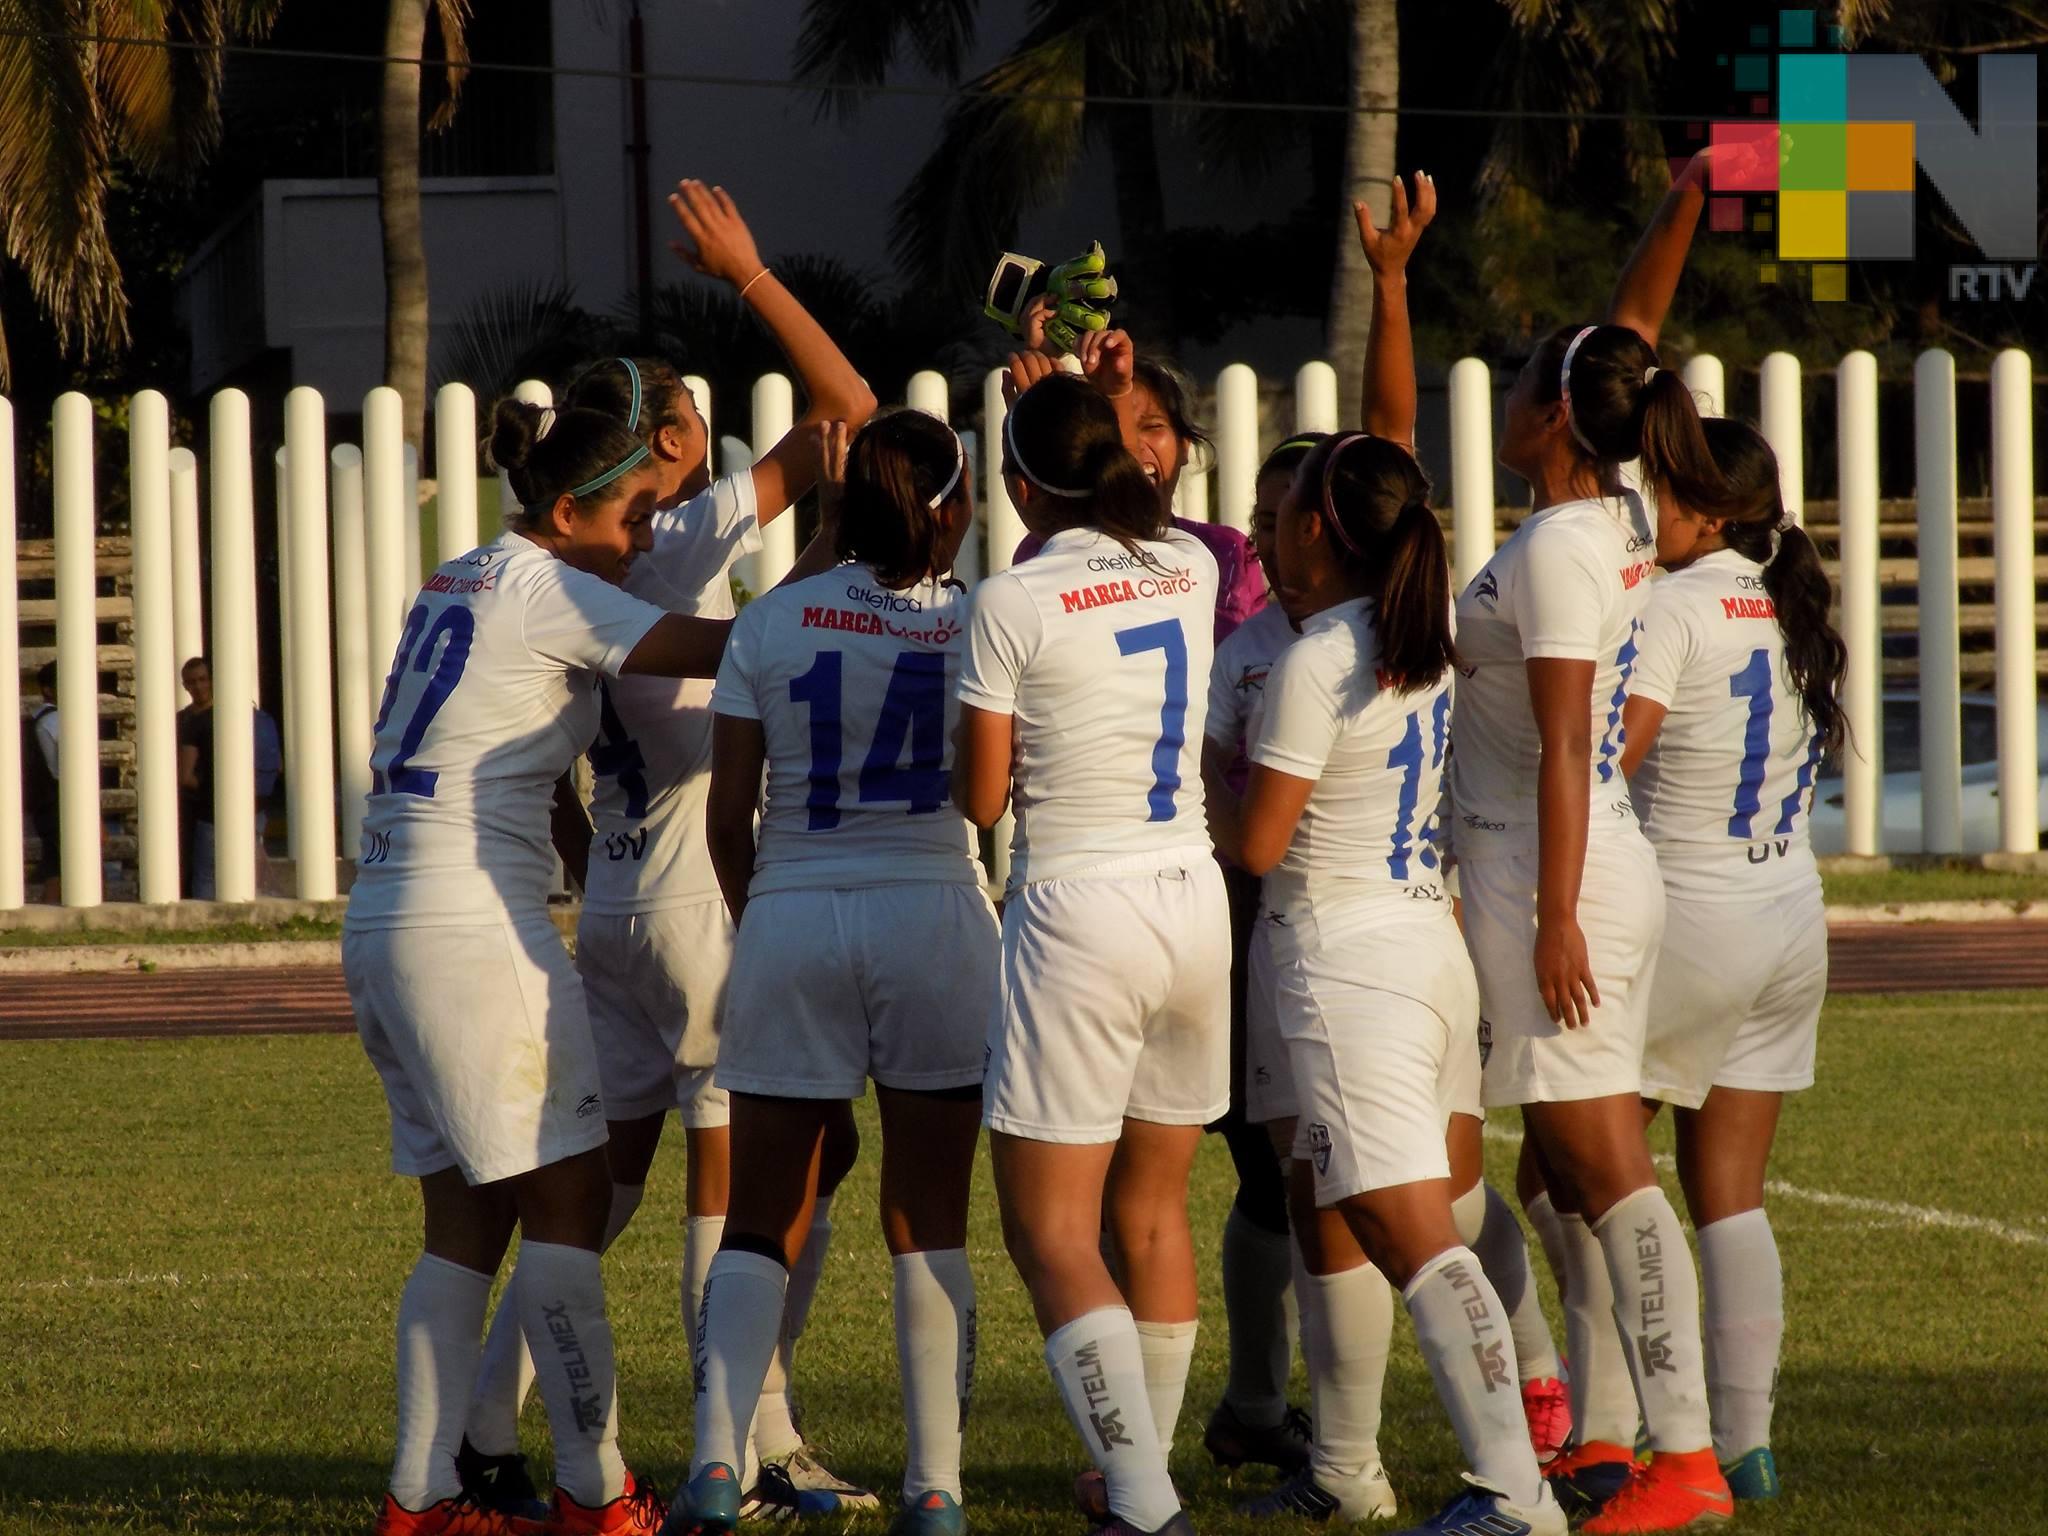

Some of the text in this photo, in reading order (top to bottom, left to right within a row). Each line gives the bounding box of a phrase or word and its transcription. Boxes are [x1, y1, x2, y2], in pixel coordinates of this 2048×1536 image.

[802, 607, 884, 636] MARCA
[847, 585, 922, 613] atletica
[1060, 576, 1193, 613] MARCA Claro
[1720, 597, 1776, 619] MARCA
[790, 651, 951, 831] 14
[1114, 618, 1188, 822] 7
[1747, 840, 1789, 864] UV
[1438, 1260, 1494, 1339] TELM
[1635, 1220, 1664, 1331] TELMEX
[543, 1302, 592, 1394] TELMEX
[1075, 1340, 1110, 1410] TELM
